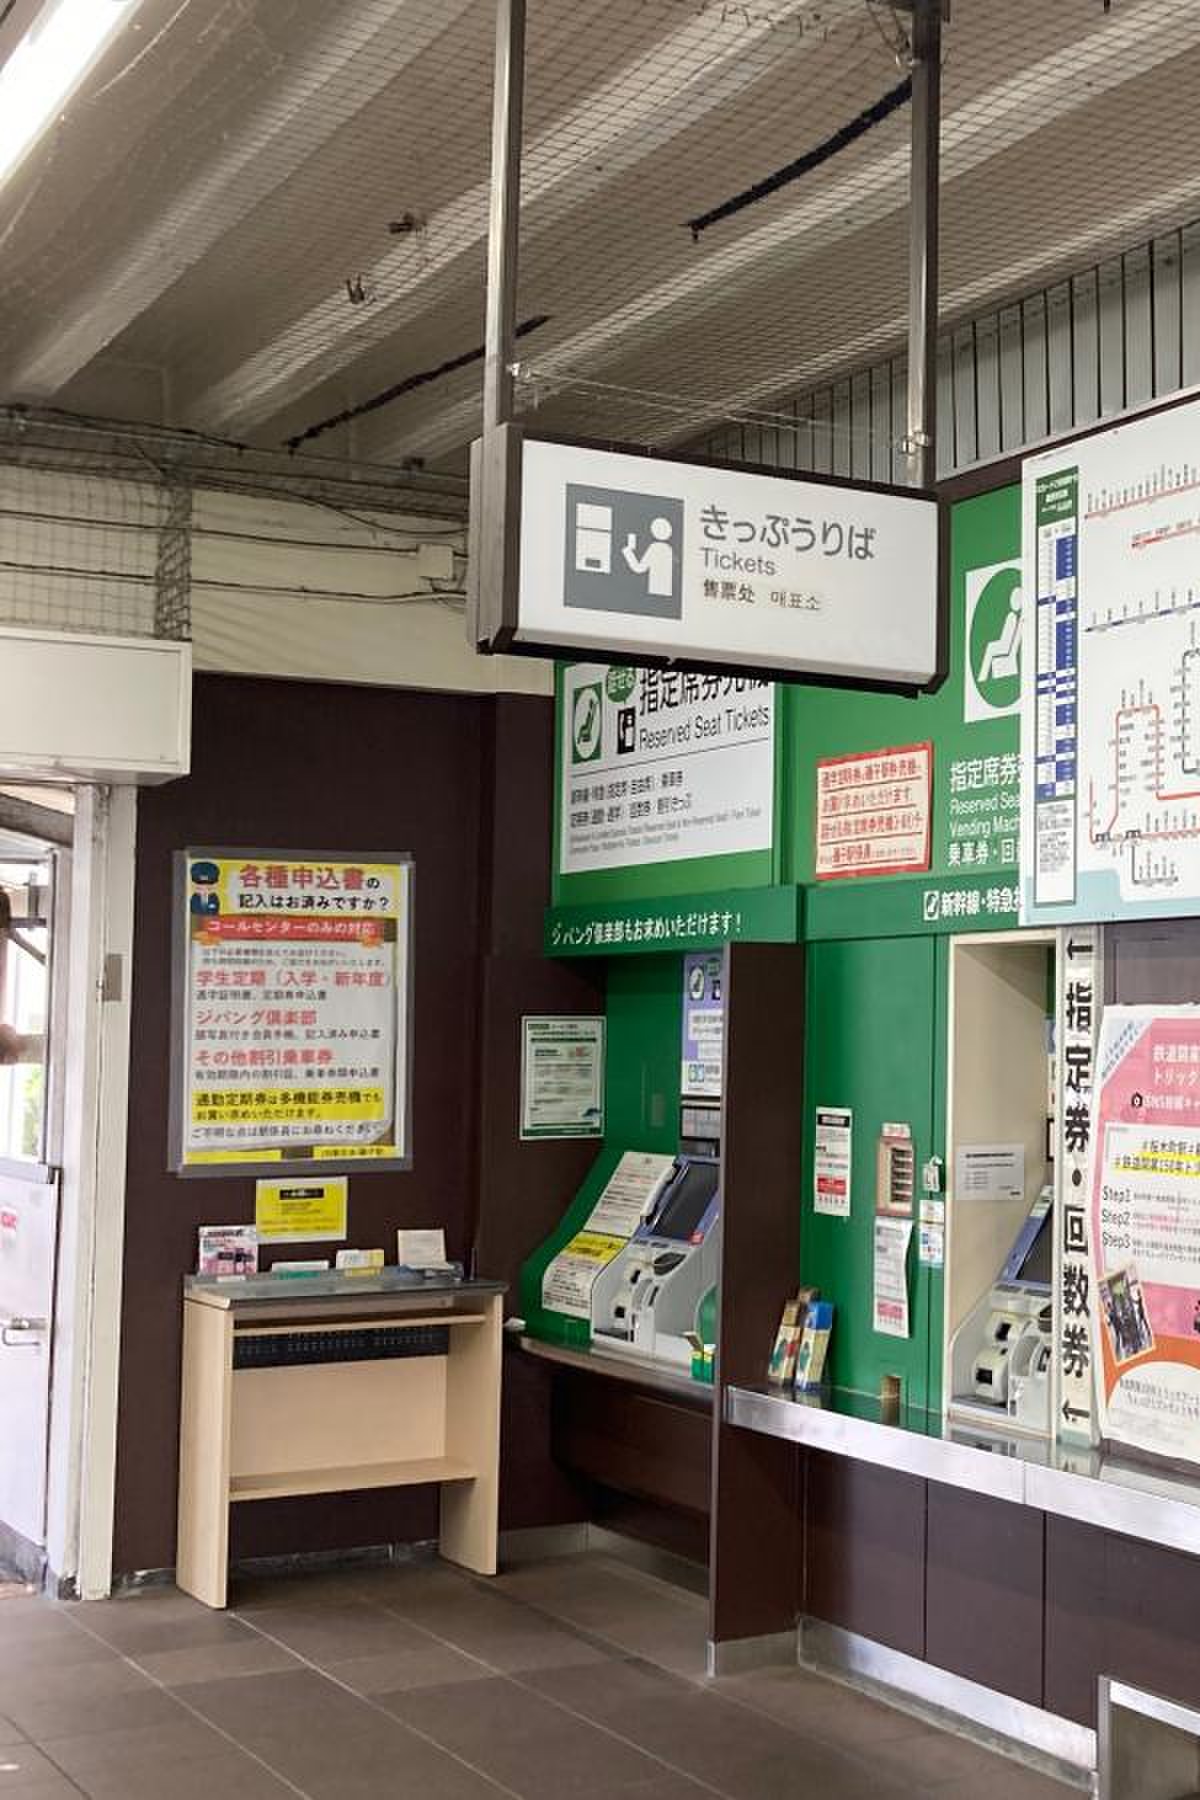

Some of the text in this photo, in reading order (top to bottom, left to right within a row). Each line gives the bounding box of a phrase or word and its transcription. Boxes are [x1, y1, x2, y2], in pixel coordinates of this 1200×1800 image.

[699, 504, 876, 561] きっぷうりば
[700, 547, 776, 577] Tickets
[771, 585, 821, 611] 매표소
[639, 704, 769, 751] Reserved Seat Tickets
[950, 797, 999, 815] Reserved
[950, 820, 991, 839] Vending
[948, 838, 1021, 866] 乗車券・回
[240, 864, 380, 891] 各種申込書の
[1063, 980, 1093, 1379] 指定券・回数券
[1102, 1185, 1131, 1204] Step1
[1101, 1208, 1130, 1228] Step2
[1101, 1232, 1131, 1249] Step3
